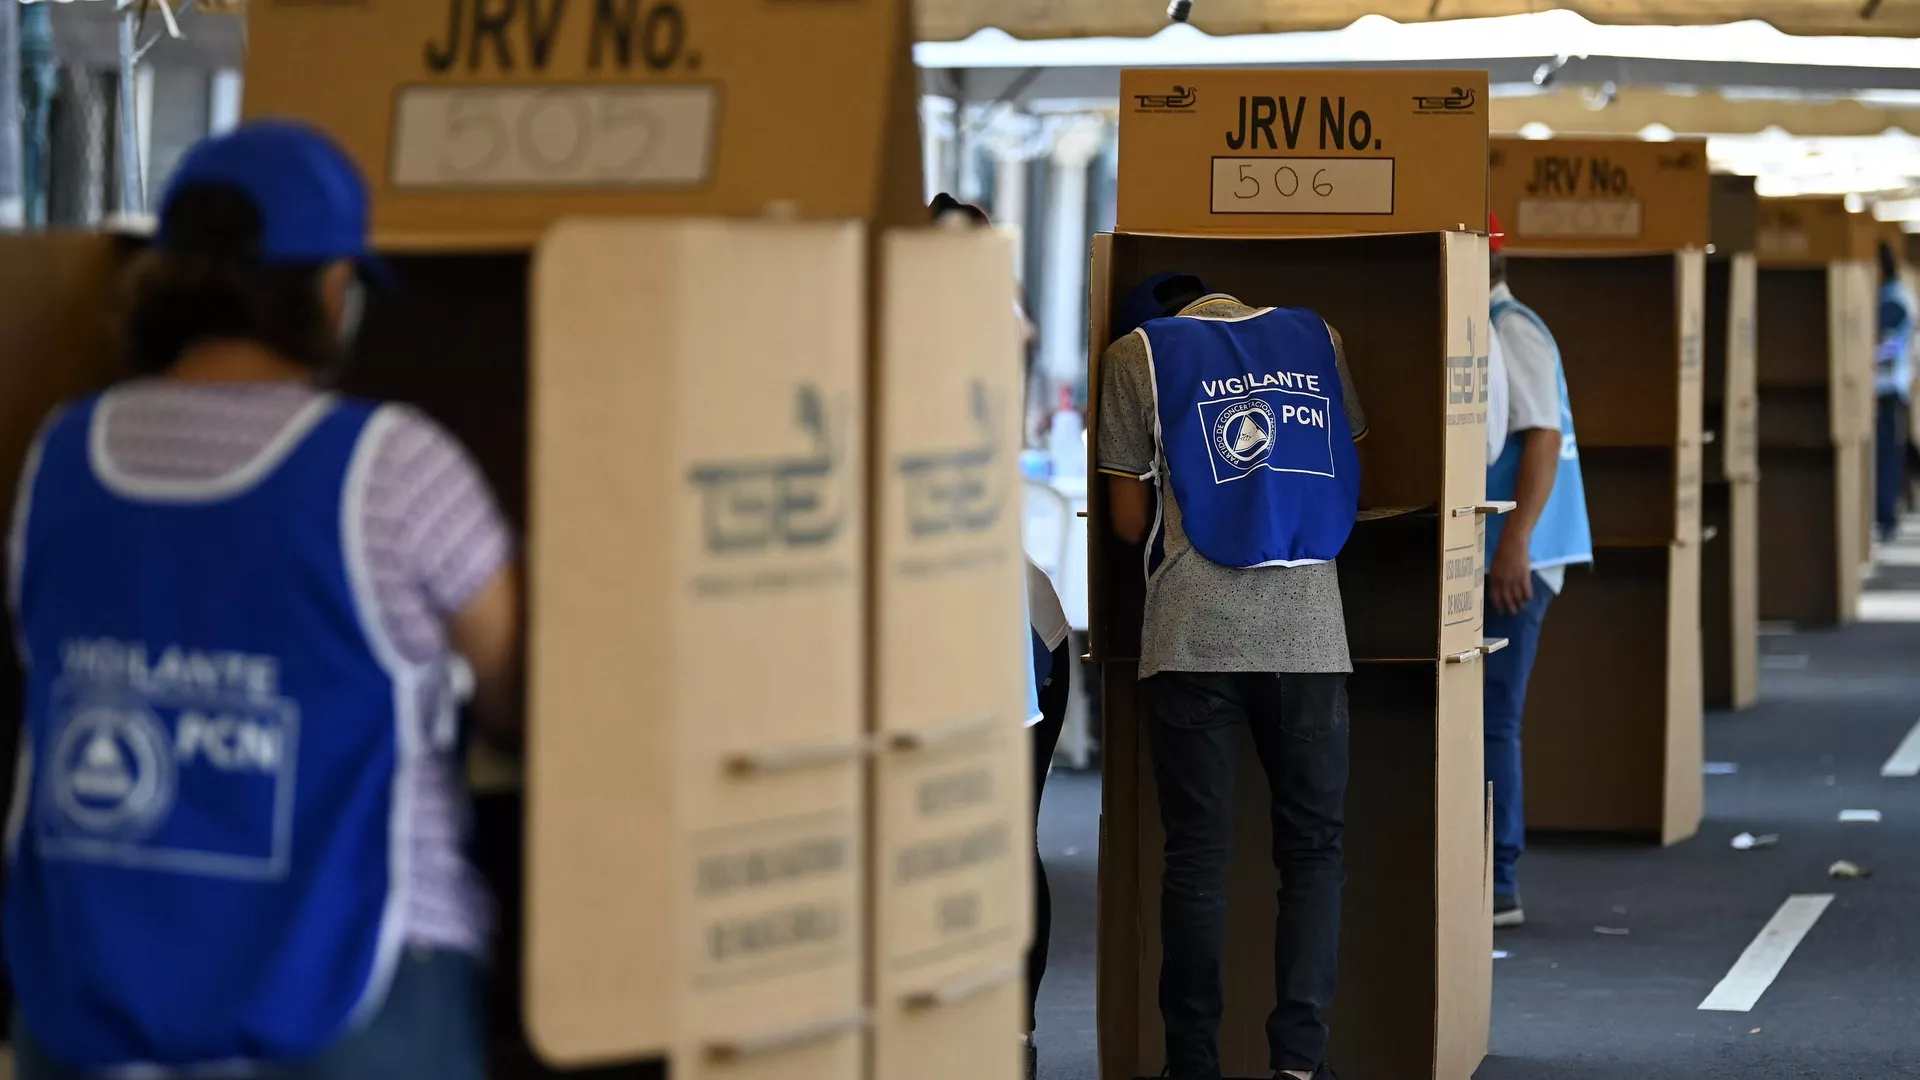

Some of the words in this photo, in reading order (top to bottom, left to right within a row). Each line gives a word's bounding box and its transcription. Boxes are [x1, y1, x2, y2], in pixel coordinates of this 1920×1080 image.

[426, 0, 563, 72] JRV
[1226, 96, 1306, 150] JRV
[1319, 96, 1382, 150] No.
[1234, 164, 1333, 199] 506
[1525, 156, 1582, 195] JRV
[1202, 371, 1321, 398] VIGILANTE
[1220, 401, 1272, 423] CONCERTACION
[1282, 405, 1324, 428] PCN
[1216, 424, 1224, 434] DE
[1216, 436, 1240, 465] PARTIDO
